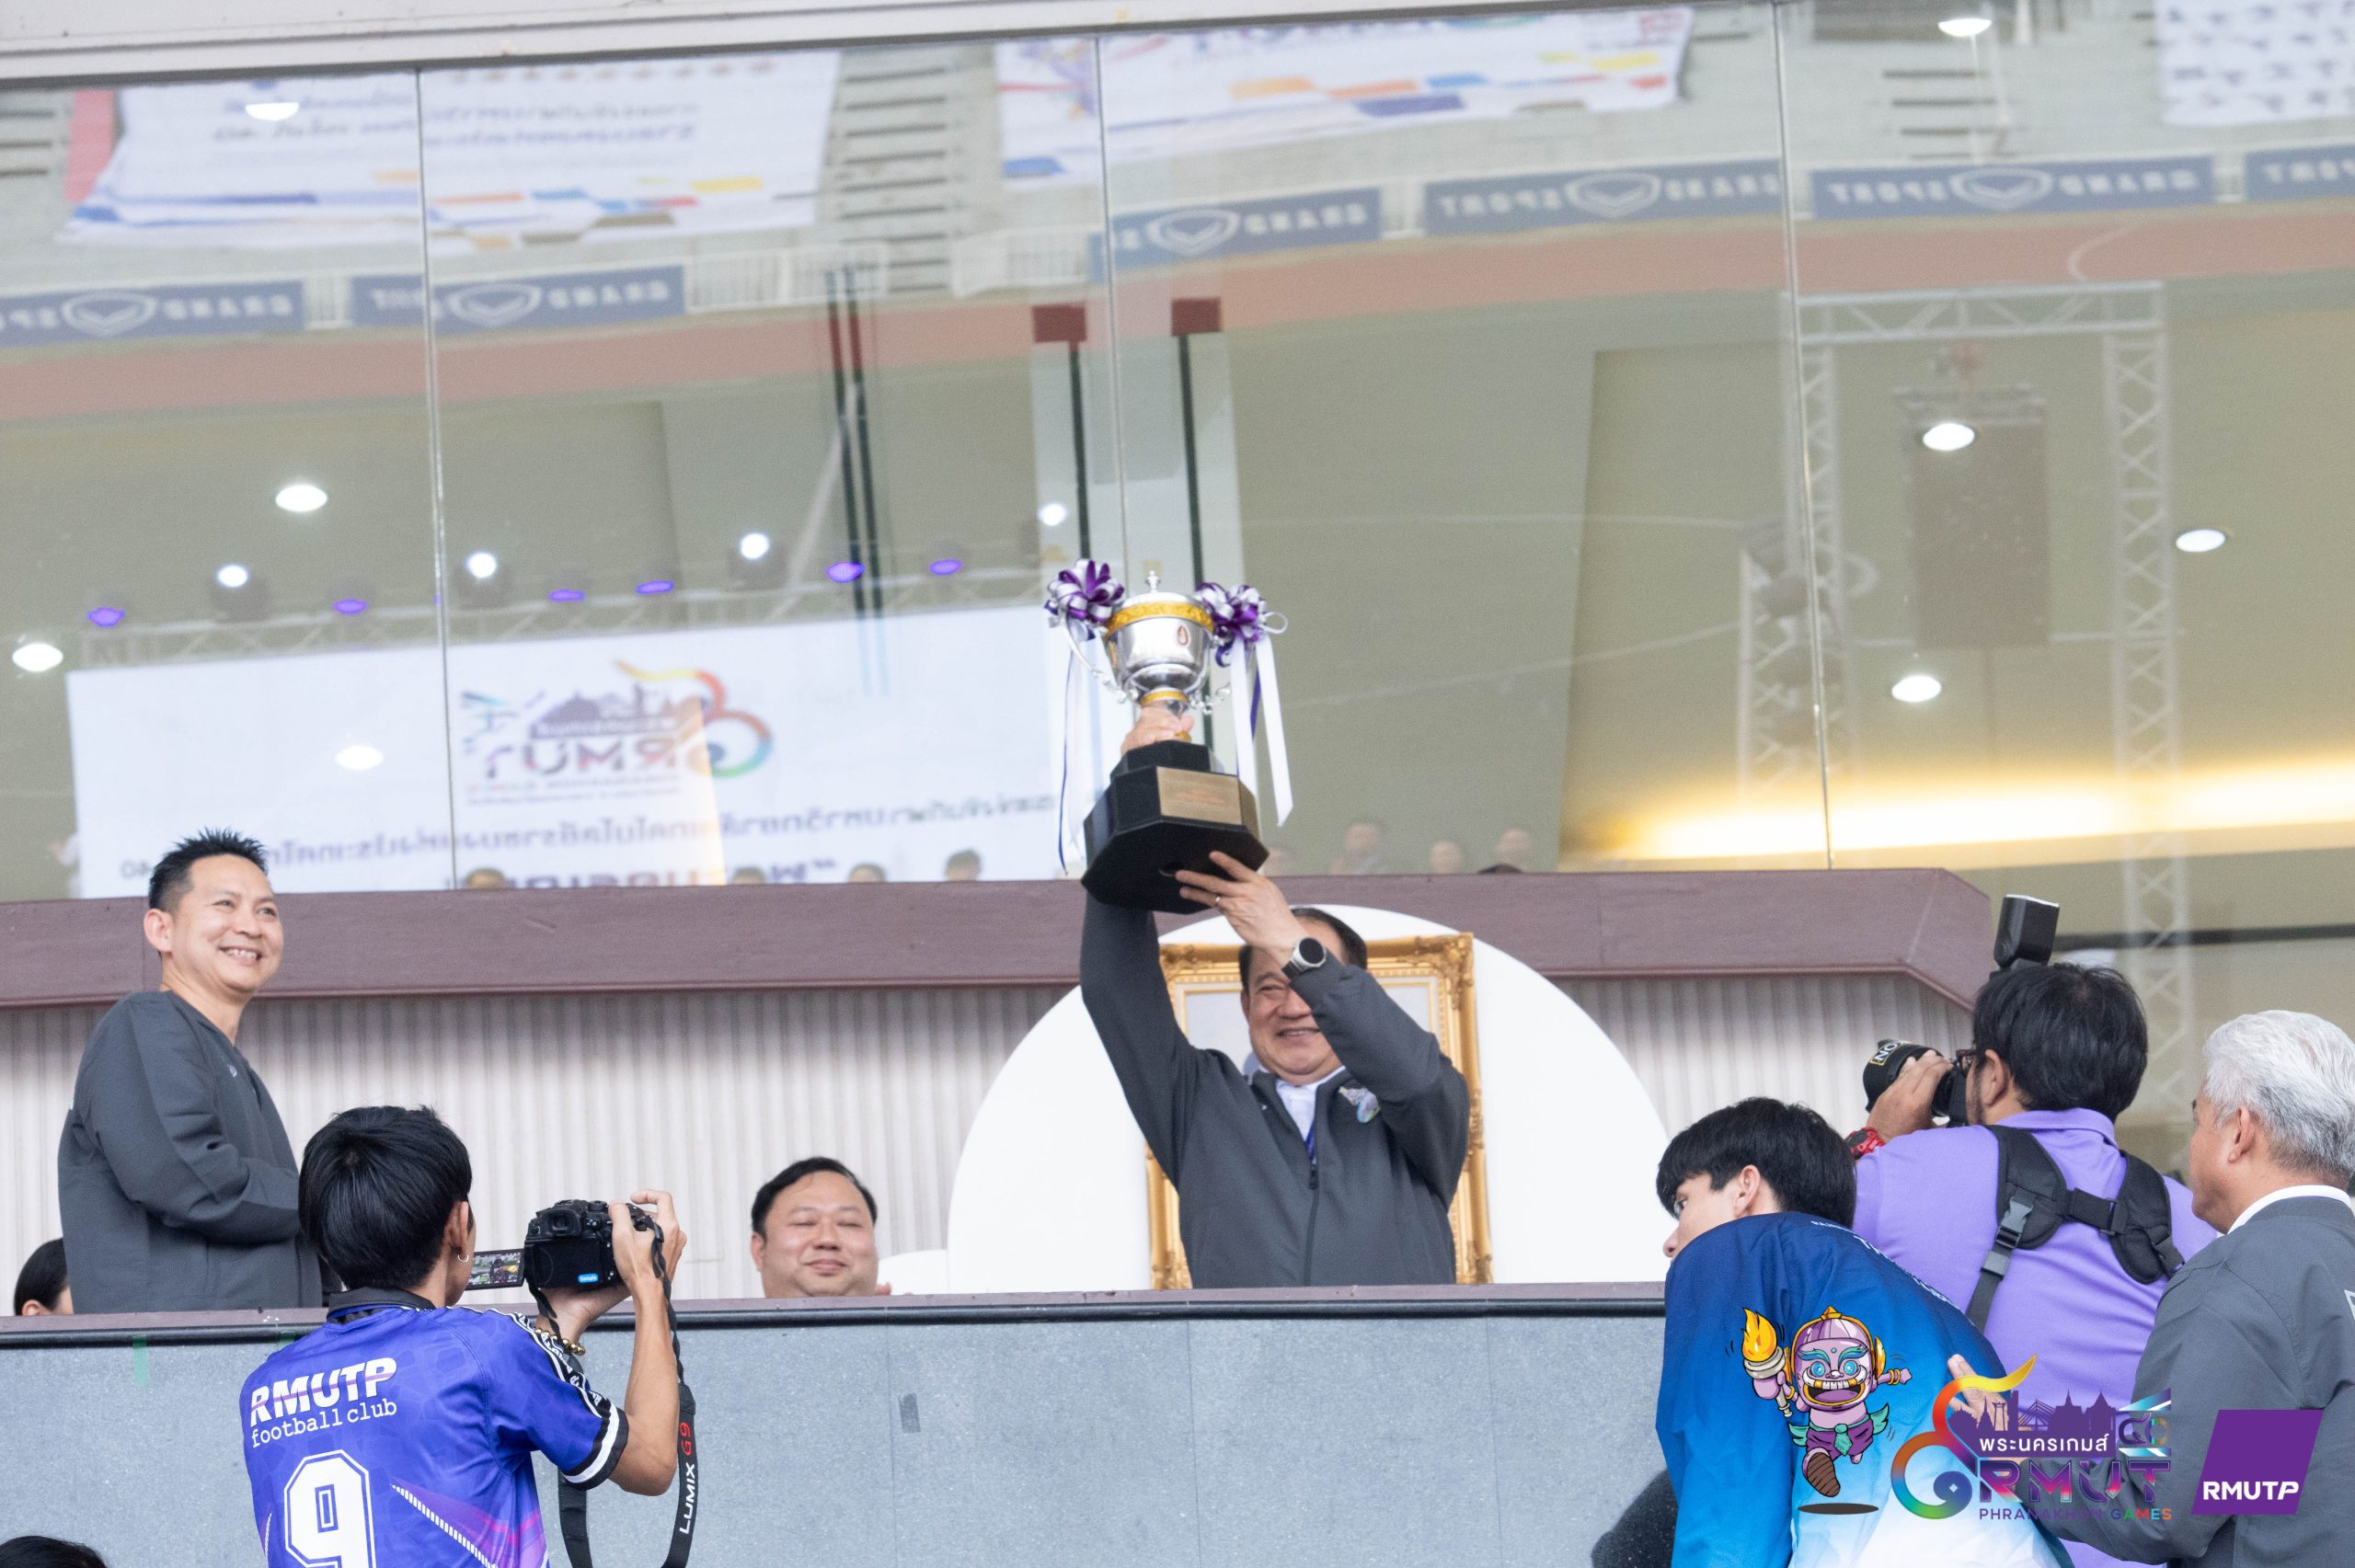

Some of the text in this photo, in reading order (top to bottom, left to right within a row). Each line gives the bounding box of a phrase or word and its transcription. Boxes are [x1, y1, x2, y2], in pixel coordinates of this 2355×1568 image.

[250, 1357, 397, 1426] RMUTP
[251, 1398, 397, 1448] football club
[283, 1449, 377, 1568] 9
[679, 1422, 695, 1535] LUMIX G9
